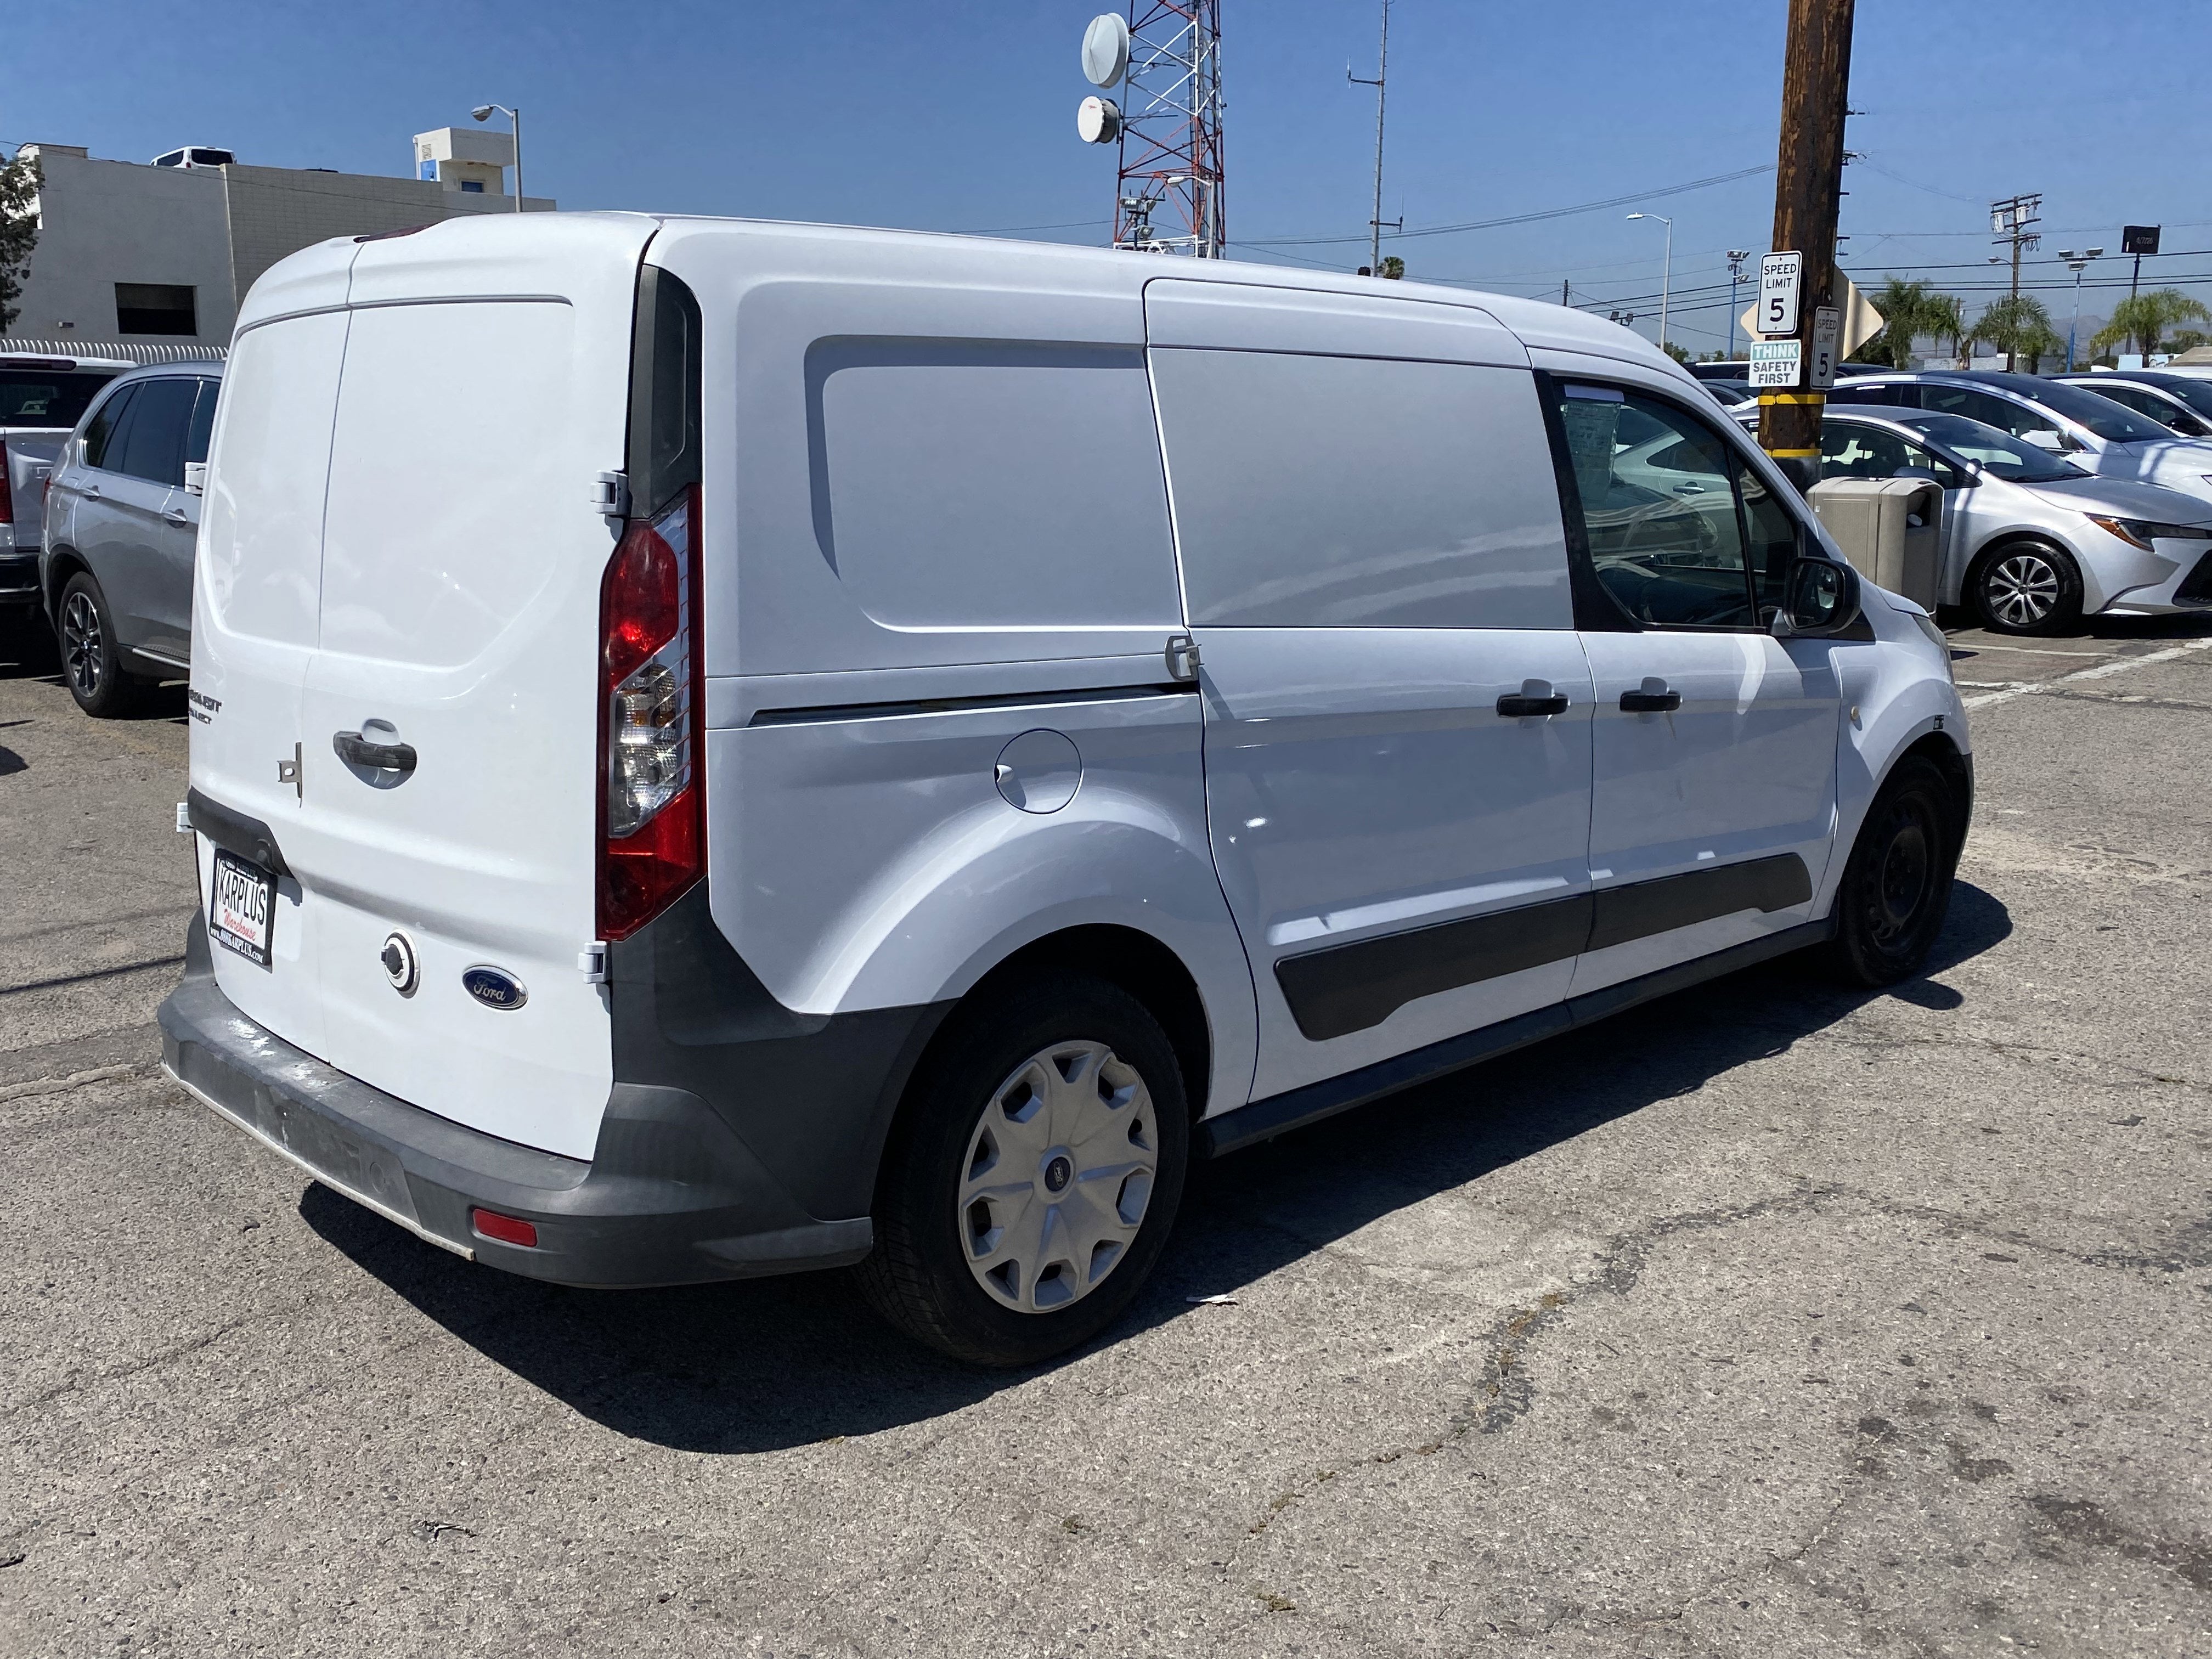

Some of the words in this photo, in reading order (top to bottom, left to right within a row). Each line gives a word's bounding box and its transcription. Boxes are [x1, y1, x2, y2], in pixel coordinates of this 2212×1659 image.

[1764, 264, 1796, 275] SPEED
[1766, 278, 1792, 289] LIMIT
[1769, 298, 1785, 322] 5
[1818, 319, 1837, 329] SPEED
[1818, 333, 1834, 343] LIMIT
[1754, 344, 1798, 358] THINK
[1753, 361, 1797, 372] SAFETY
[1819, 353, 1829, 376] 5
[1758, 373, 1791, 383] FIRST
[219, 867, 266, 925] KARPLUS
[224, 909, 256, 941] Warehouse
[473, 975, 506, 1001] Ford
